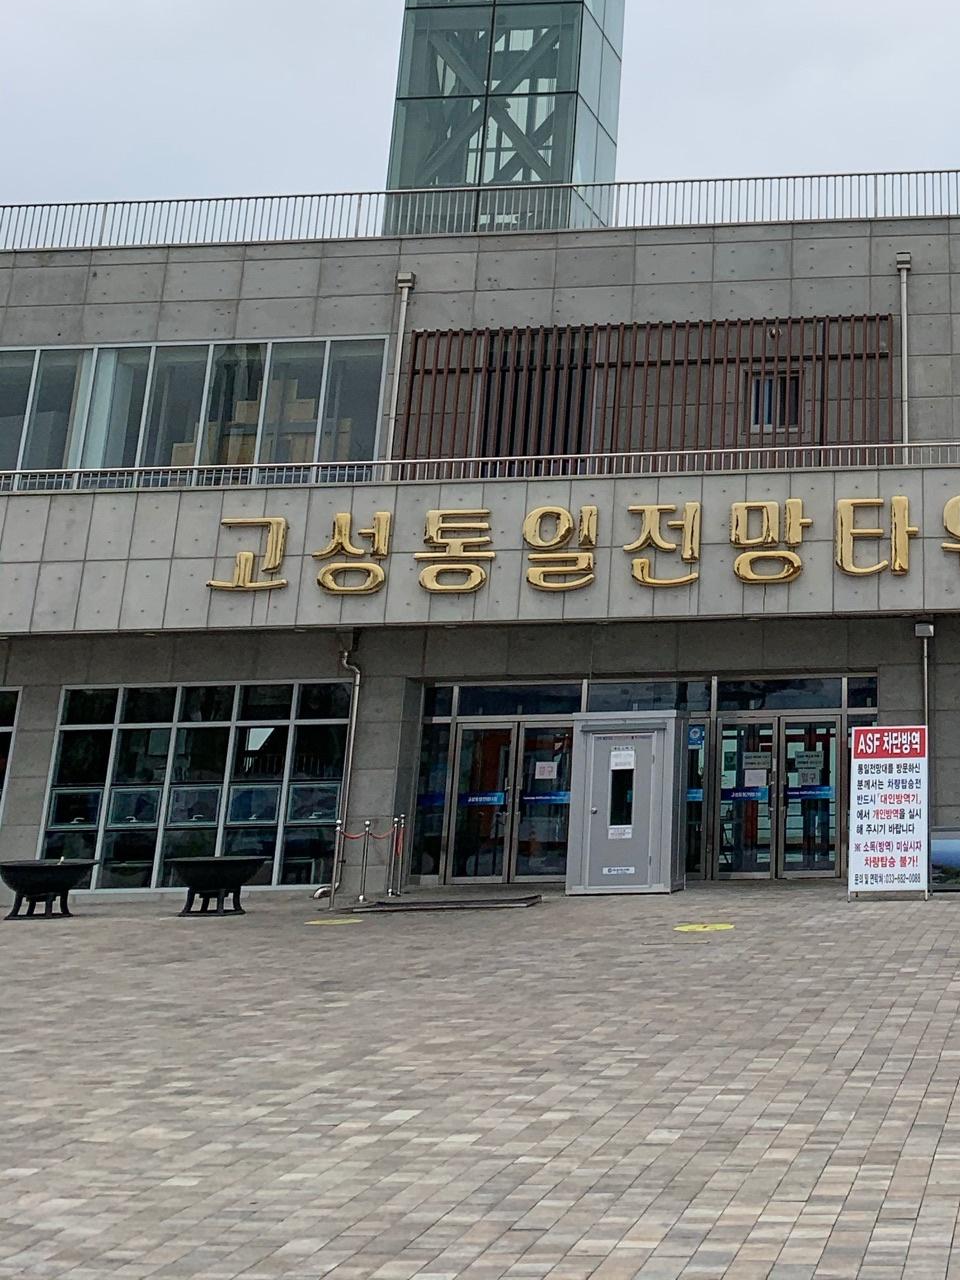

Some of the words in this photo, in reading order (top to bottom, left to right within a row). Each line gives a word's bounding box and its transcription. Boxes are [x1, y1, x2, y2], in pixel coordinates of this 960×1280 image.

[857, 733, 881, 754] ASF
[882, 731, 921, 754] 차단방역
[857, 763, 894, 775] 통일전망대를
[896, 762, 921, 774] 방문하신
[856, 779, 884, 790] 분께서는
[856, 809, 870, 820] 에서
[872, 808, 905, 820] 개인방역을
[908, 808, 922, 819] 실시
[856, 824, 863, 835] 해
[865, 823, 886, 835] 주시기
[888, 823, 915, 834] 바랍니다
[896, 840, 922, 852] 미실시자
[864, 855, 896, 868] 차량탑승
[899, 855, 918, 868] 불가!
